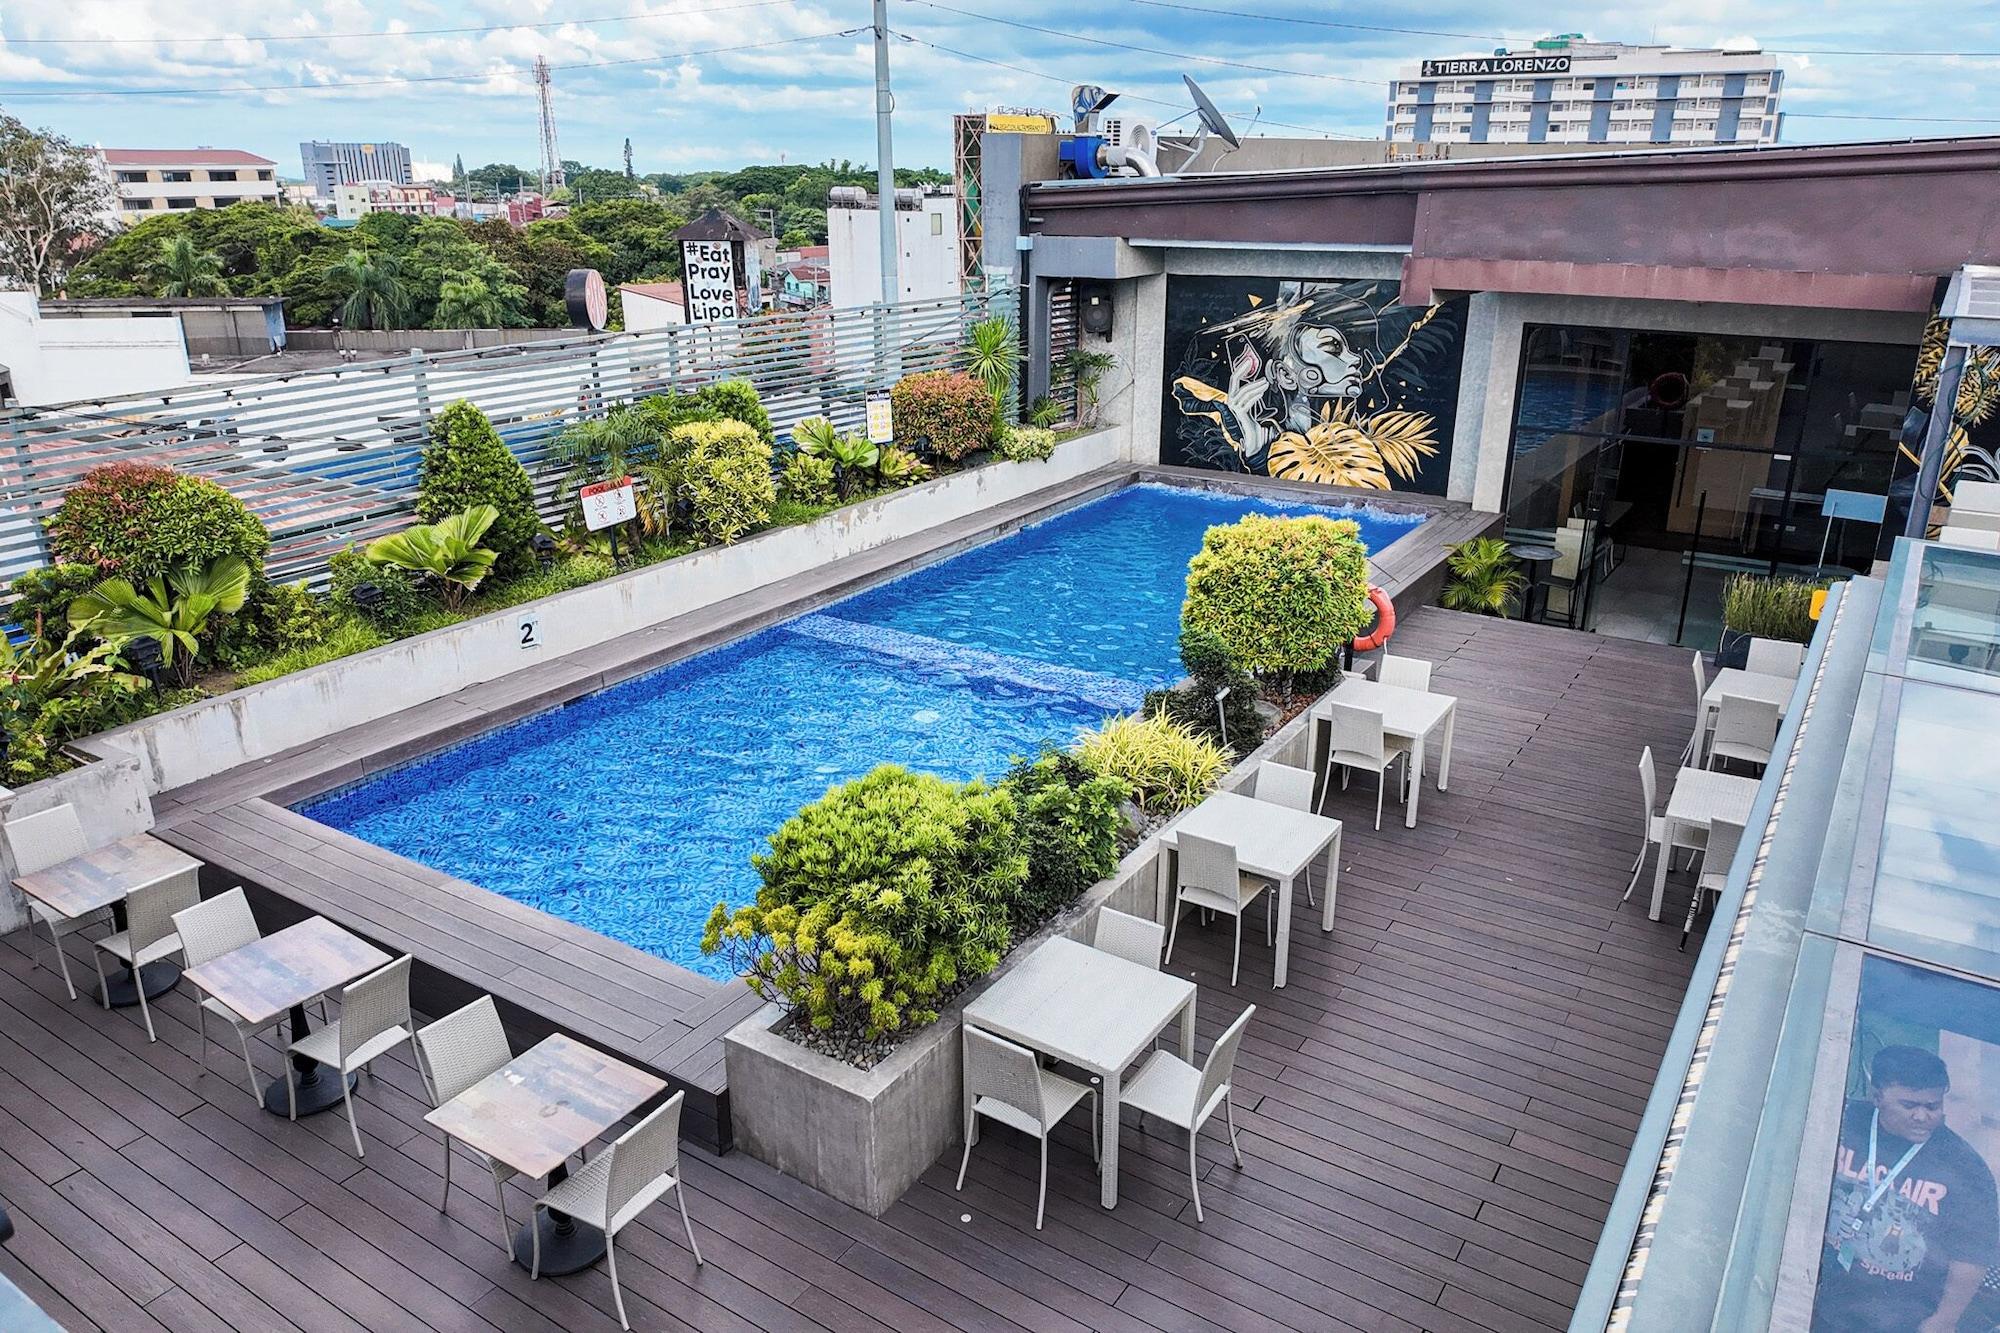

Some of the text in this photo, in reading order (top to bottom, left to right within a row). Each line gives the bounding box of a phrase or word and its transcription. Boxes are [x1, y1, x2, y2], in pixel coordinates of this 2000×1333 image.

[1435, 57, 1569, 74] TIERRA LORENZO
[686, 242, 730, 262] #Eat
[688, 263, 730, 283] Pray
[690, 283, 733, 301] Love
[692, 302, 734, 322] Lipa
[521, 623, 534, 644] 2
[1899, 1177, 1947, 1215] AIR
